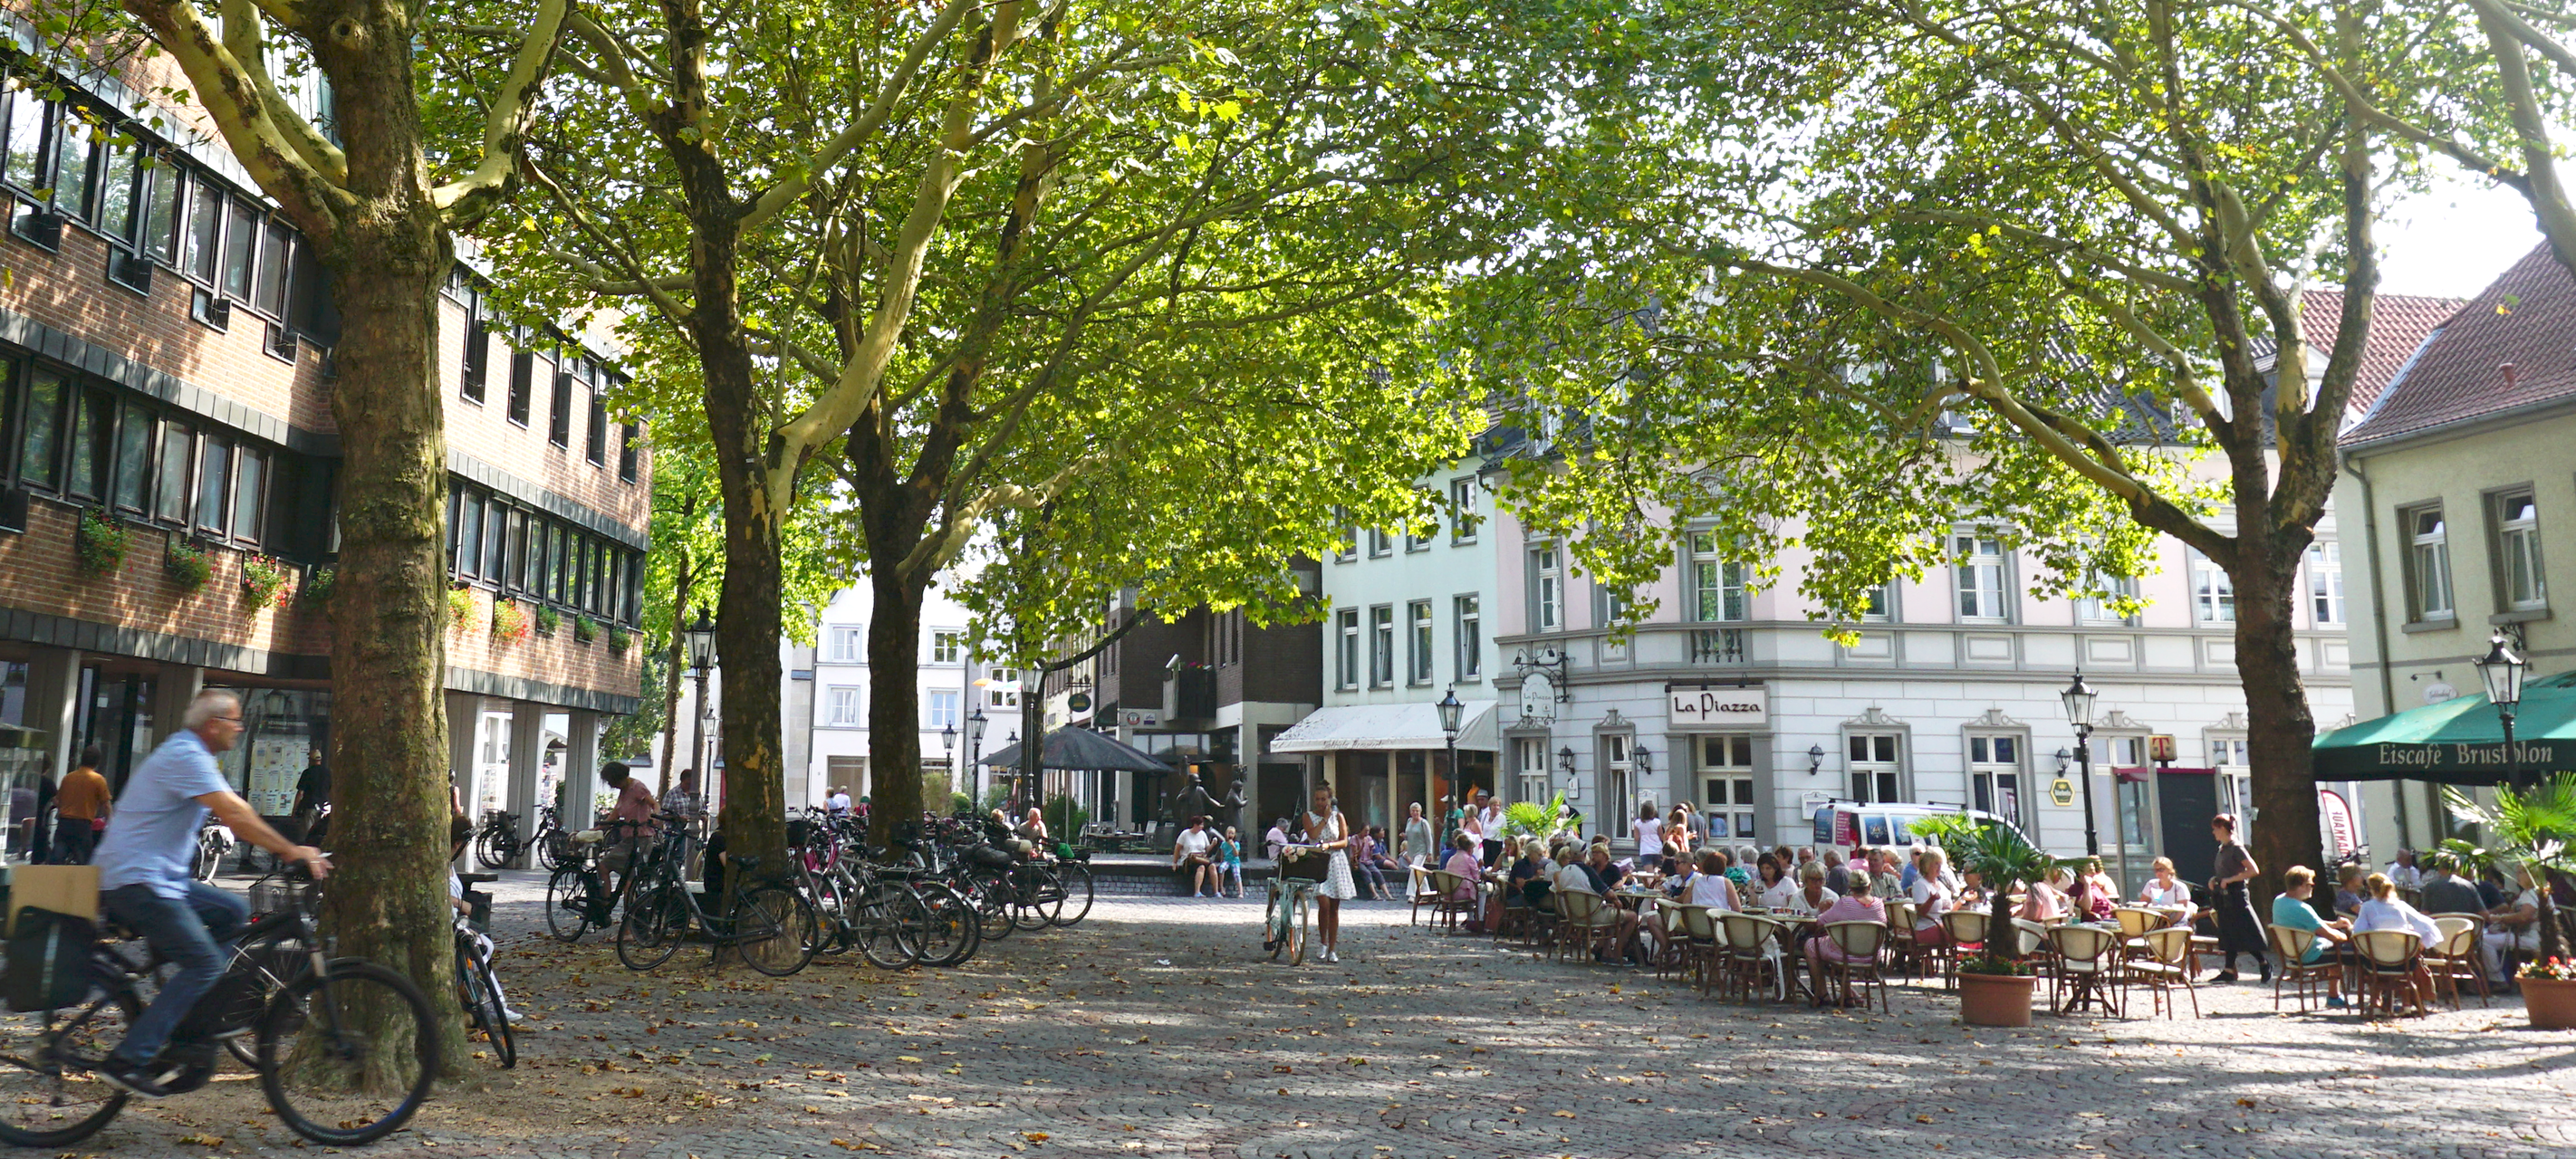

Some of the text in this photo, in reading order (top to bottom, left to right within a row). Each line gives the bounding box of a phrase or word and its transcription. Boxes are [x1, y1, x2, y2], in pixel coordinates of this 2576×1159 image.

[1532, 692, 1552, 702] Piazza
[1674, 693, 1762, 721] La Piazza
[2152, 737, 2169, 759] T
